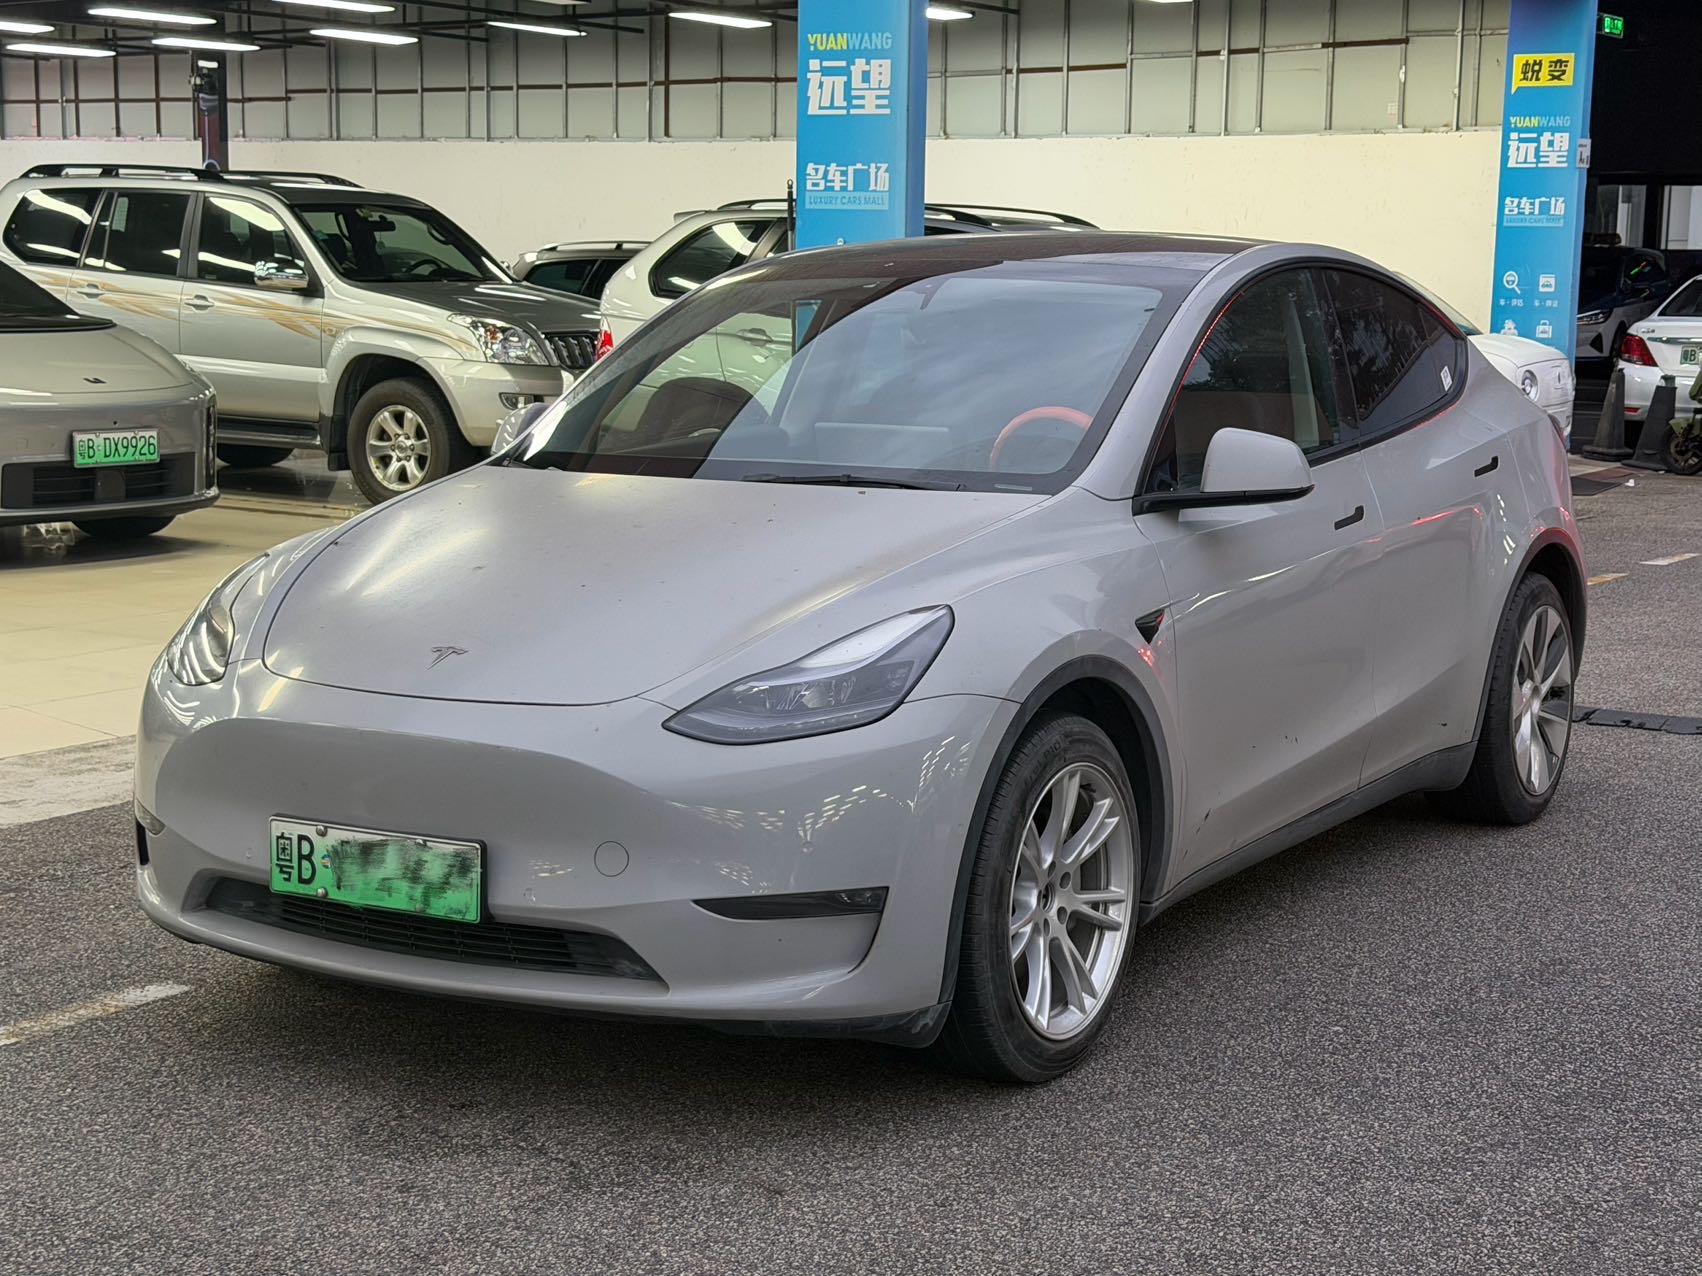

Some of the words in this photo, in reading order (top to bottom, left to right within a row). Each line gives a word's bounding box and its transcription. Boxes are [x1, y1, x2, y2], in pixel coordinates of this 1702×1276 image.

[807, 32, 892, 51] YUANWANG
[1519, 58, 1570, 82] 蜕变
[806, 58, 891, 115] 远望
[1509, 115, 1571, 128] YUANWANG
[1507, 131, 1570, 168] 远望
[805, 162, 890, 191] 名车广场
[808, 195, 838, 205] LUXURY
[840, 195, 863, 206] CARS
[864, 195, 885, 206] MALL
[1504, 196, 1566, 215] 名车广场
[103, 435, 156, 458] DX9926
[275, 832, 317, 885] 粤B
